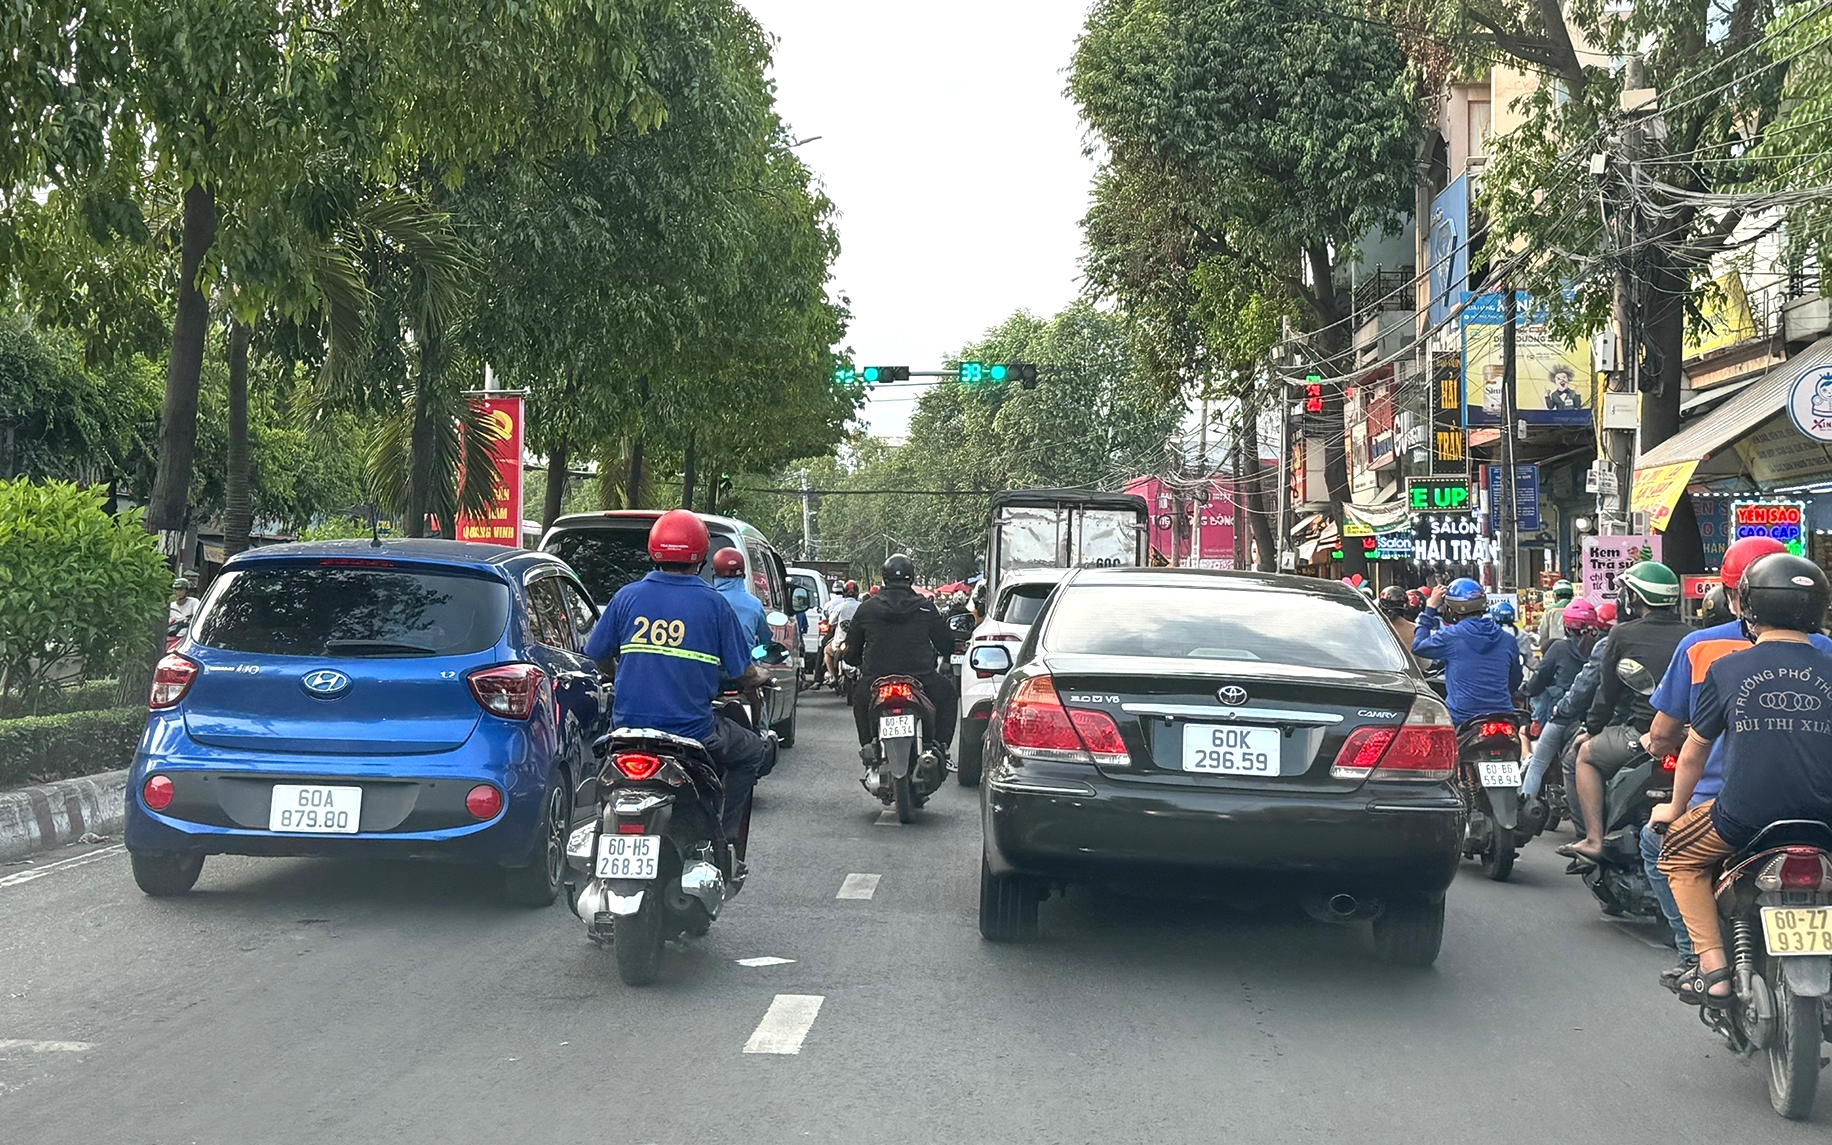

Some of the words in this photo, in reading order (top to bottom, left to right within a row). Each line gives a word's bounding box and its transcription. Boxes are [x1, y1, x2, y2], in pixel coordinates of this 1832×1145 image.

[961, 363, 982, 382] 39
[1433, 486, 1468, 507] UP
[1737, 525, 1767, 540] CAO
[1590, 547, 1621, 558] Kem
[630, 616, 686, 647] 269
[1105, 695, 1120, 704] V6
[1735, 669, 1775, 716] TRƯỜNG
[1778, 666, 1812, 681] PHỔ
[1357, 709, 1398, 719] CAMRY
[1764, 718, 1793, 733] THỊ
[1212, 728, 1251, 749] 60K
[1194, 749, 1268, 772] 296.59
[298, 788, 334, 808] 60A
[281, 809, 349, 829] 879.80
[608, 838, 650, 856] 60-H5
[600, 857, 655, 876] 268.35
[1774, 909, 1828, 930] 60-Z7
